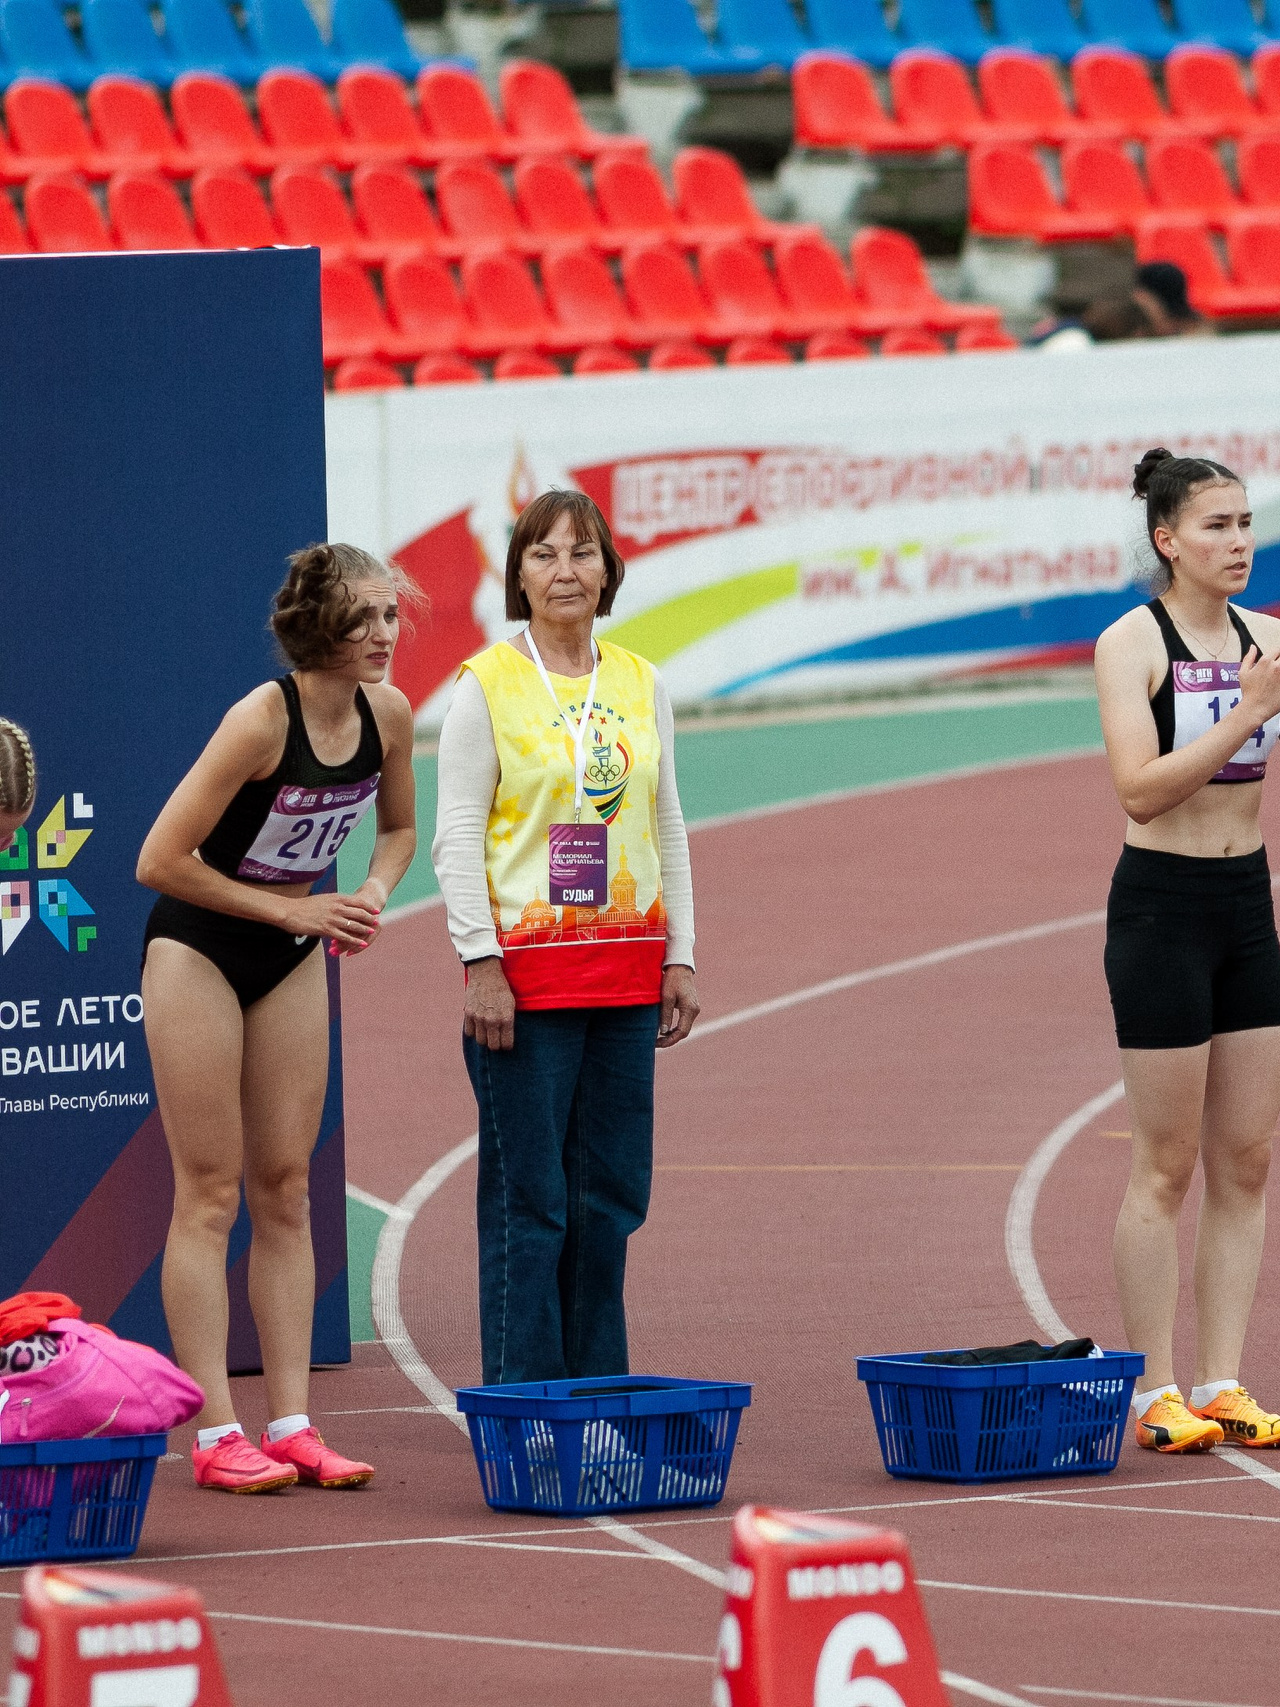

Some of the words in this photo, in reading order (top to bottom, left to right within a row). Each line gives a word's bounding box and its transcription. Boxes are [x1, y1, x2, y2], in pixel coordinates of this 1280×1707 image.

[612, 454, 753, 545] ЦЕНТР
[277, 811, 358, 860] 215
[562, 889, 595, 902] СУДЬЯ
[56, 993, 145, 1026] ЛЕТО
[1, 1041, 125, 1076] ВАШИИ
[49, 1089, 150, 1112] Республики
[786, 1560, 905, 1600] MONDO
[76, 1615, 202, 1660] MONDO
